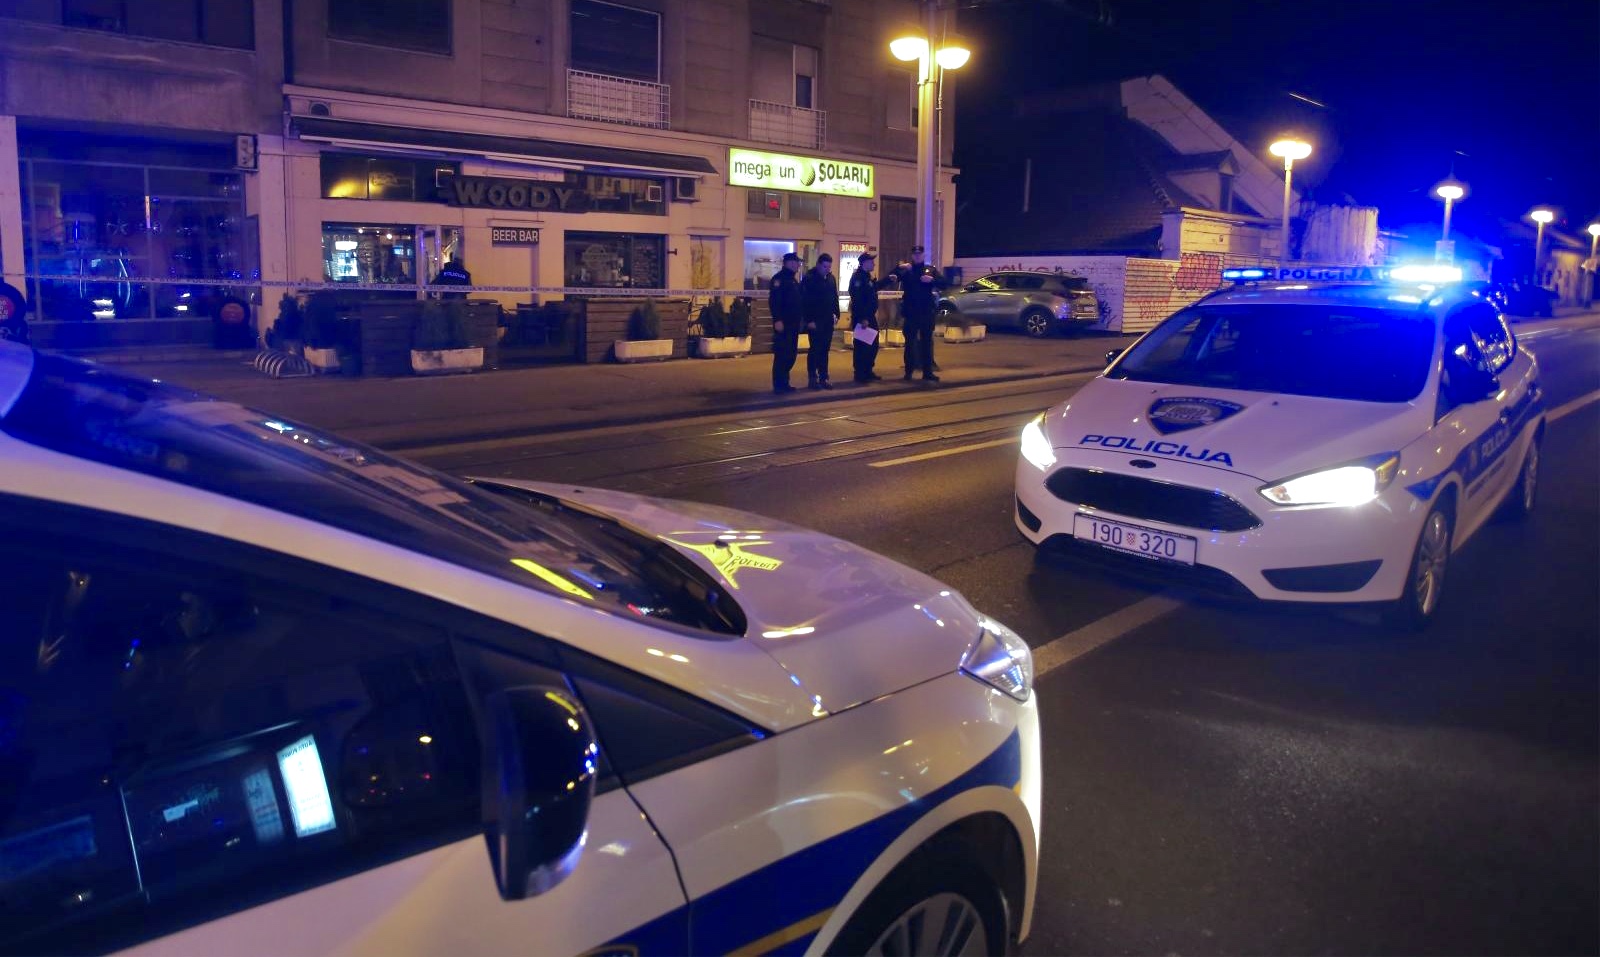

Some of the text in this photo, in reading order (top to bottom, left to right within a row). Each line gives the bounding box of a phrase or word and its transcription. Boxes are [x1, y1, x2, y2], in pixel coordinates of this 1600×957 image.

[818, 162, 870, 187] SOLARIJ
[454, 179, 574, 209] WOODY
[493, 229, 539, 242] BEER BAR
[1280, 268, 1374, 281] POLICIJA
[1079, 434, 1234, 467] POLICIJA
[1092, 521, 1122, 545] 190
[1139, 532, 1176, 557] 320
